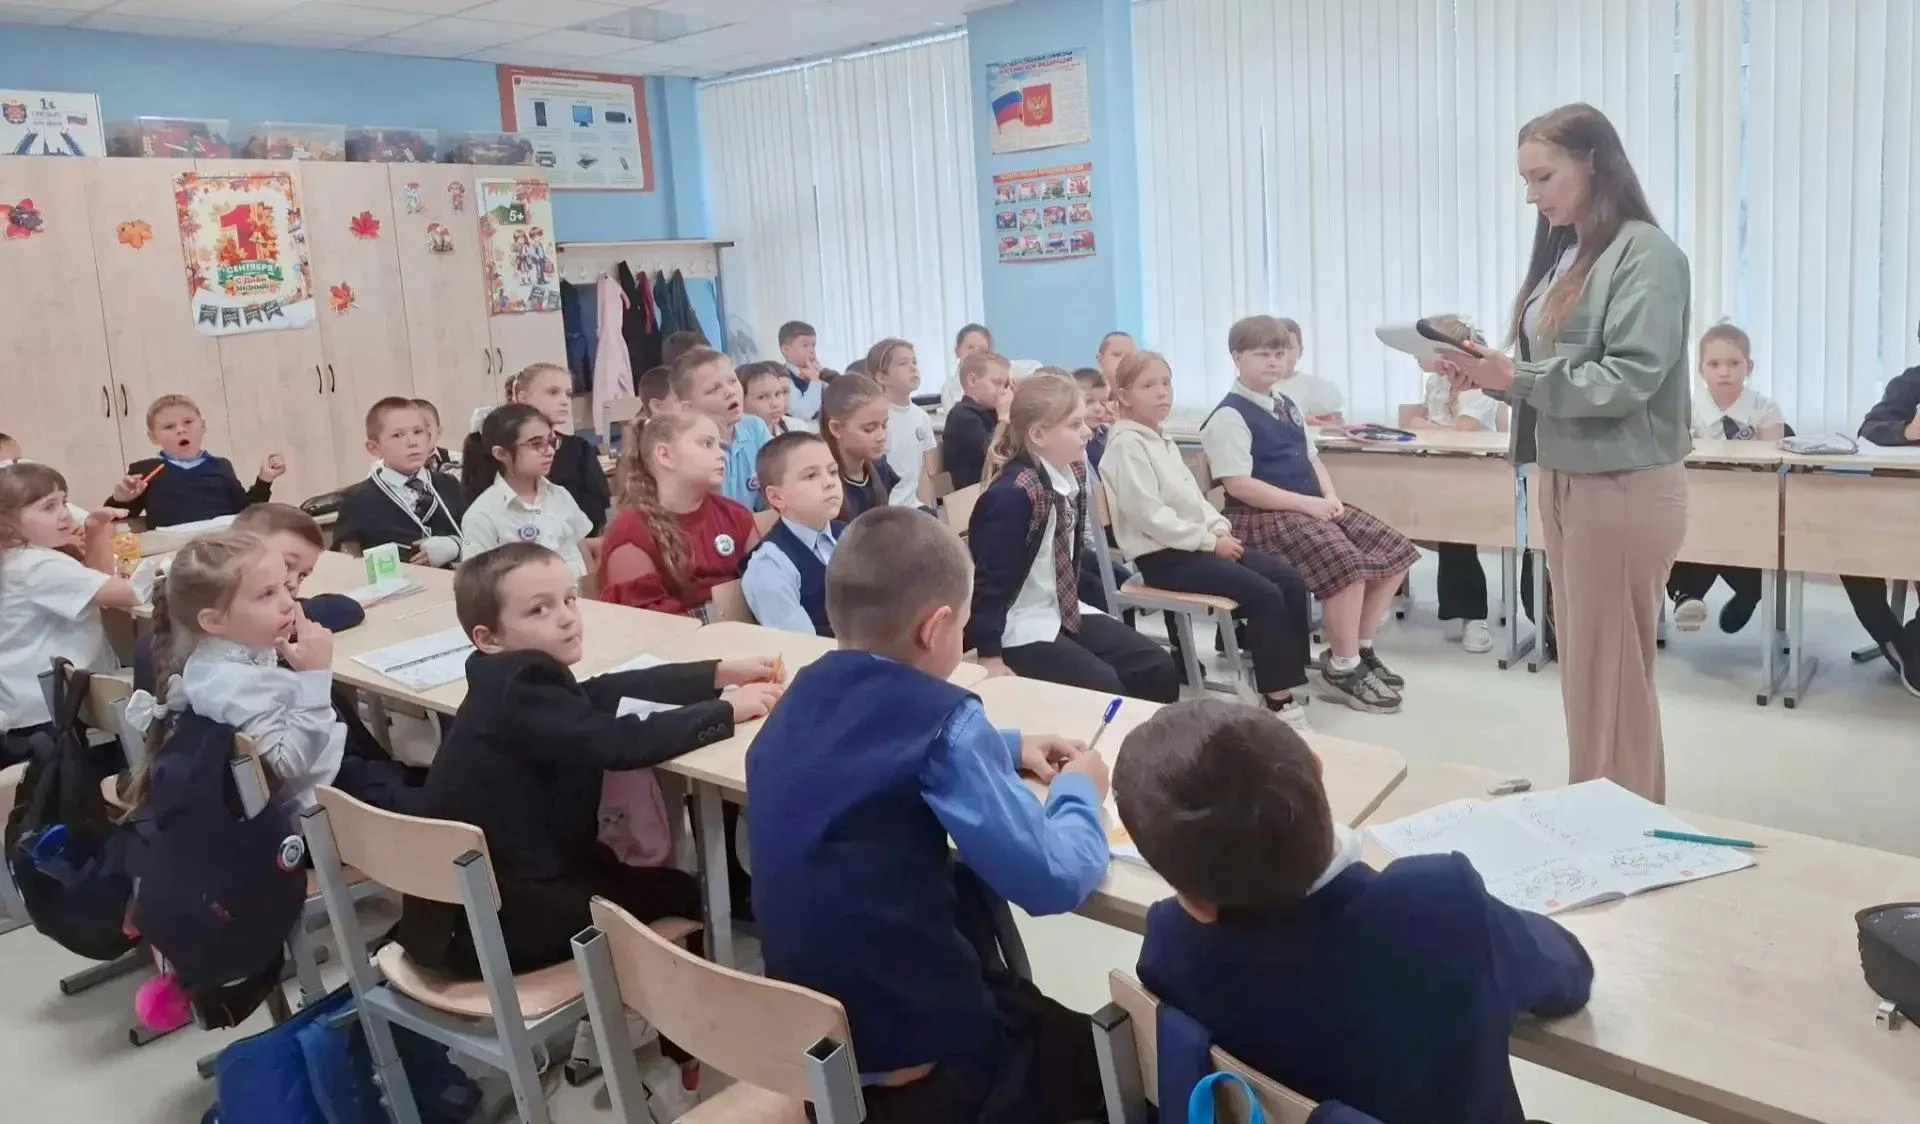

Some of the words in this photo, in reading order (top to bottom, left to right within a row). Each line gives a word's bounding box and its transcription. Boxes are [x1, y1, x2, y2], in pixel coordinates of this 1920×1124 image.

[509, 209, 524, 222] 5+
[219, 204, 260, 260] 1
[226, 263, 273, 274] СЕНТЯБРЯ
